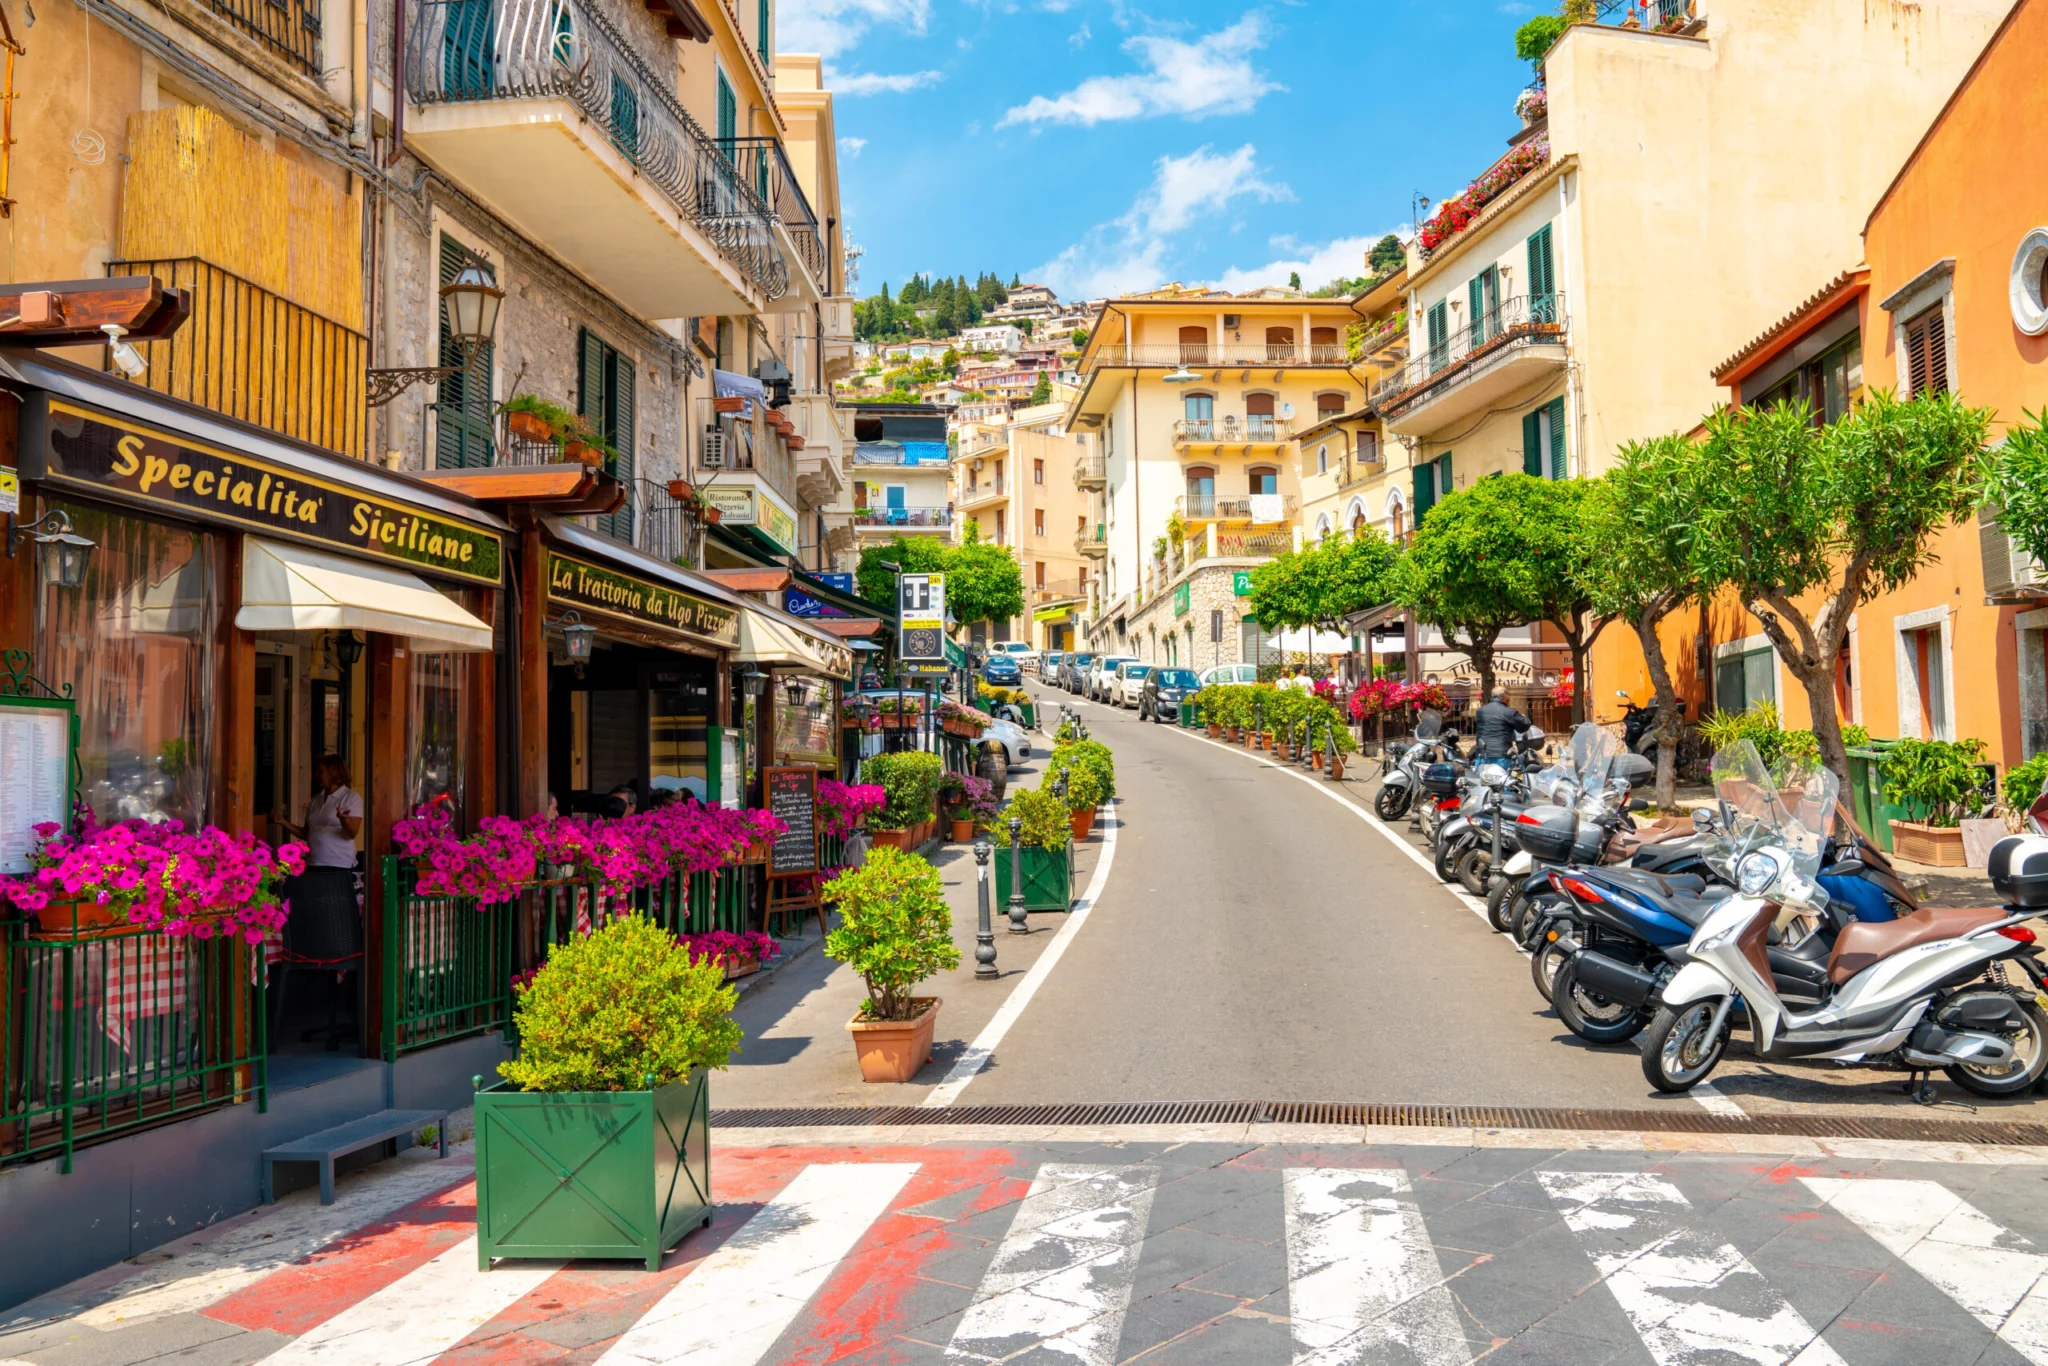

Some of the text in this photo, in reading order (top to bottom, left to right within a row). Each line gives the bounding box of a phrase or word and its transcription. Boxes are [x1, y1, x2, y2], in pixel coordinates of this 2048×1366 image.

[709, 493, 748, 502] Ristorante
[715, 502, 745, 511] Pizzeria
[349, 502, 473, 562] Siciliane
[552, 559, 738, 637] La Trattoria da Ugo Pizzeria
[919, 664, 949, 672] Habanos
[1449, 659, 1532, 678] TIRMISU
[1474, 676, 1528, 687] Ttoria
